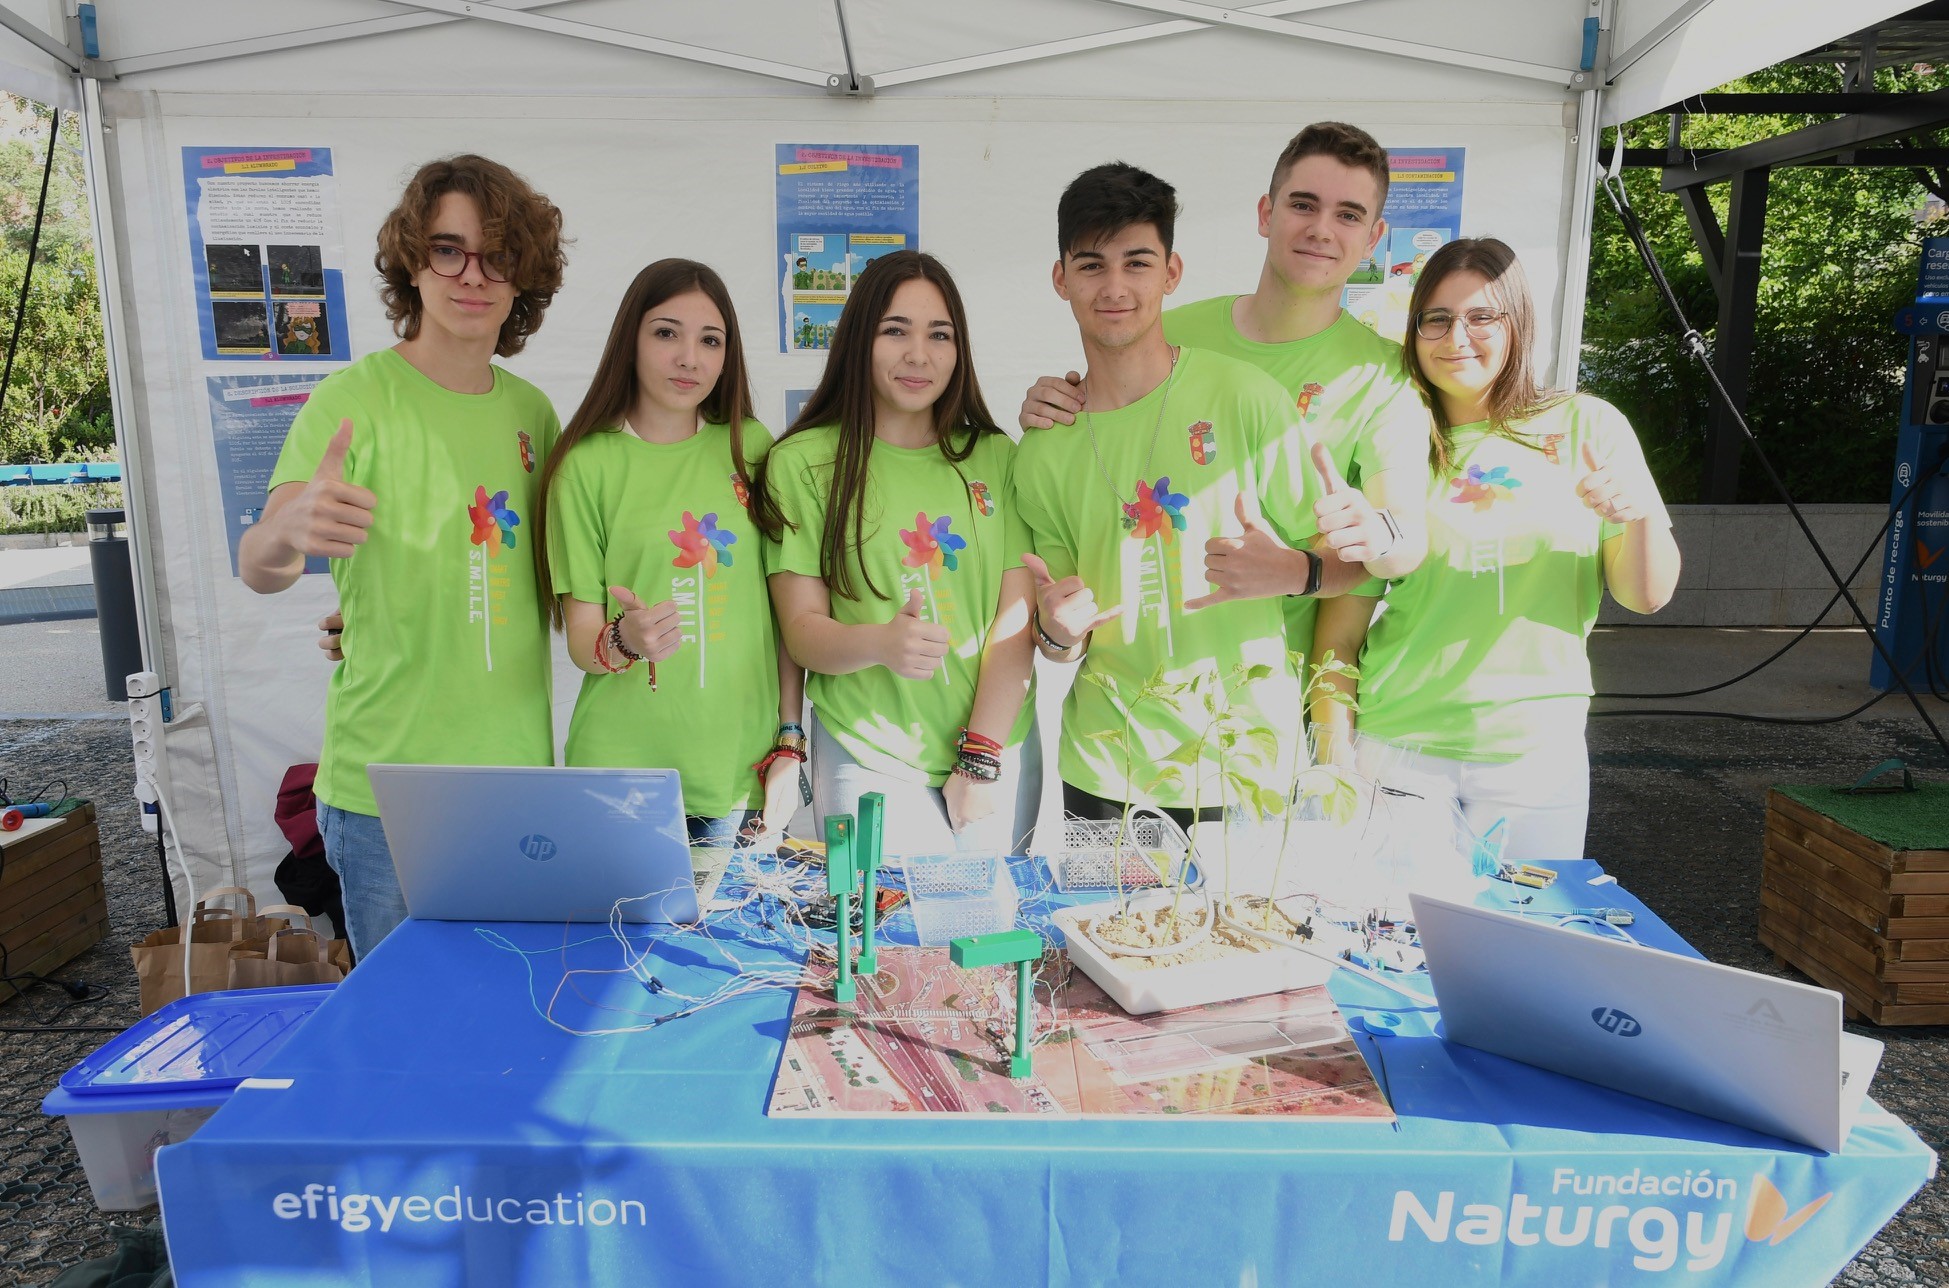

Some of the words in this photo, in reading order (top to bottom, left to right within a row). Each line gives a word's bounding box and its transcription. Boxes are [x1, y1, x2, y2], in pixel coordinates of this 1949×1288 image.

[1926, 262, 1949, 270] rese
[1890, 510, 1904, 563] recarga
[469, 550, 483, 624] S.M.I.L.E.
[1888, 567, 1896, 584] de
[1911, 574, 1947, 583] Nturgy
[1881, 587, 1894, 628] Punto
[520, 834, 557, 861] hp
[1592, 1007, 1642, 1037] hp
[1552, 1168, 1737, 1200] Fundación
[273, 1183, 647, 1233] efigyeducation
[1389, 1190, 1733, 1272] Naturgy
